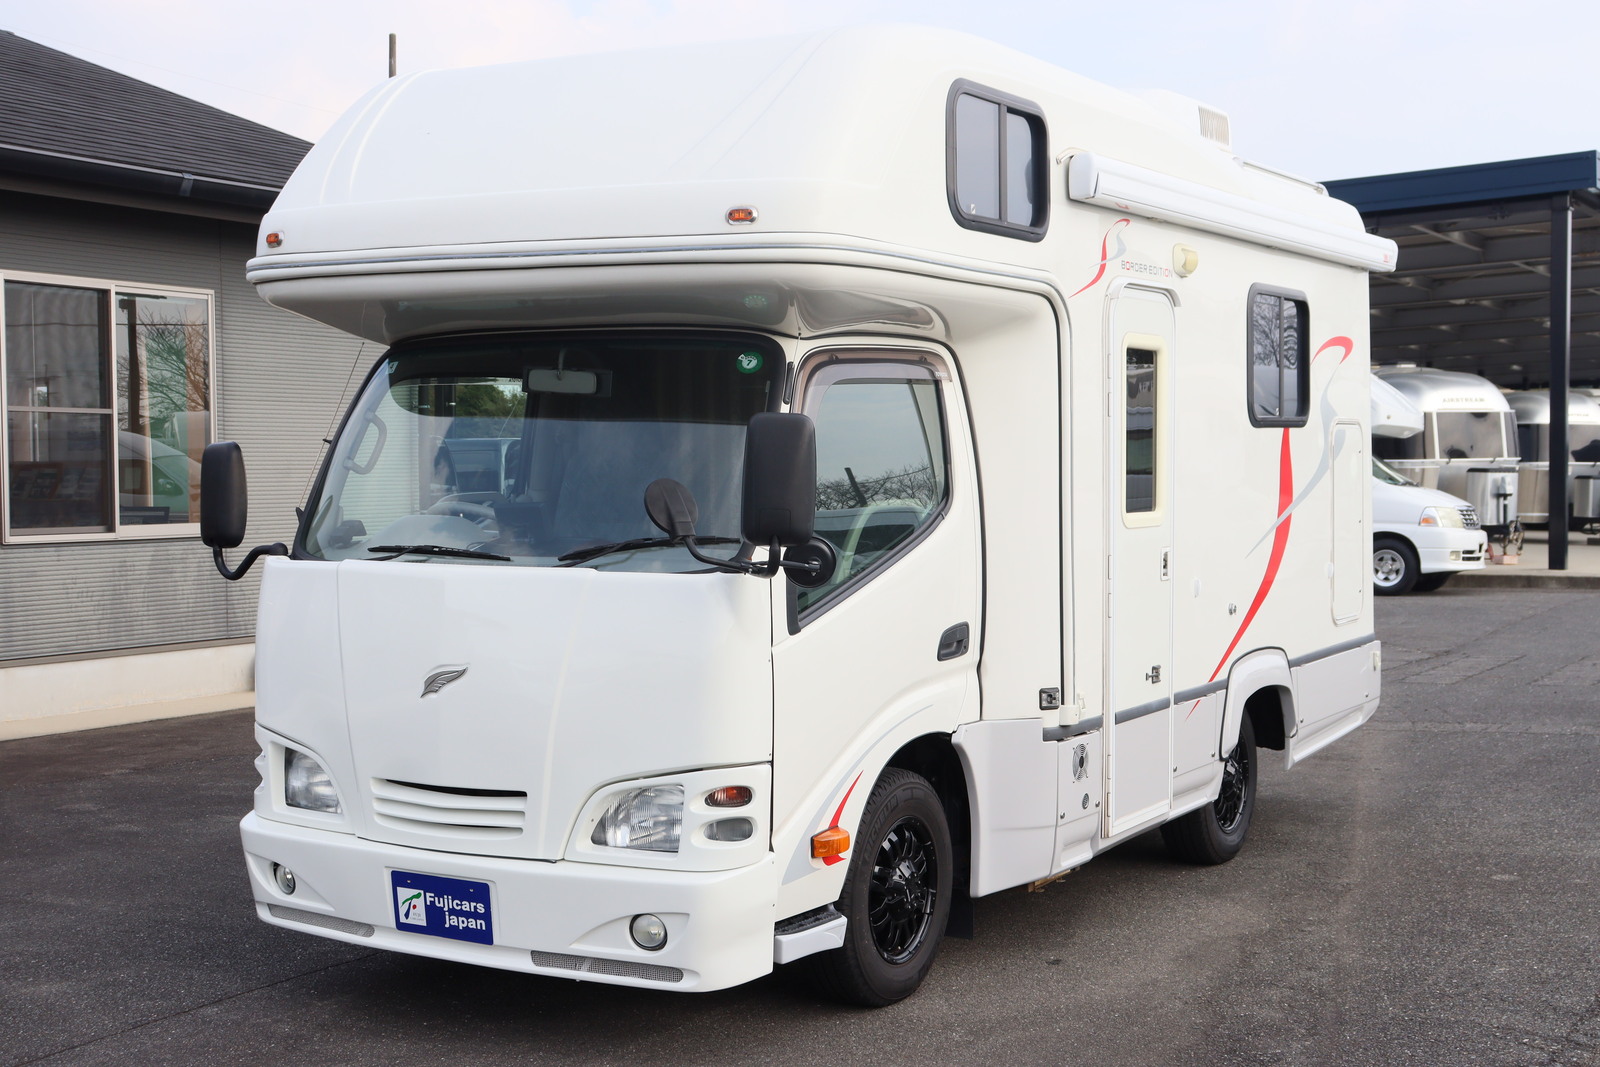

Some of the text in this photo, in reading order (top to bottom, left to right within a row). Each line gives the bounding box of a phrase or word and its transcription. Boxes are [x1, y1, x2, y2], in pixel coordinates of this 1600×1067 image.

[1121, 260, 1173, 278] BORDER EDITION
[425, 892, 486, 914] Fujicars
[444, 911, 486, 930] japan
